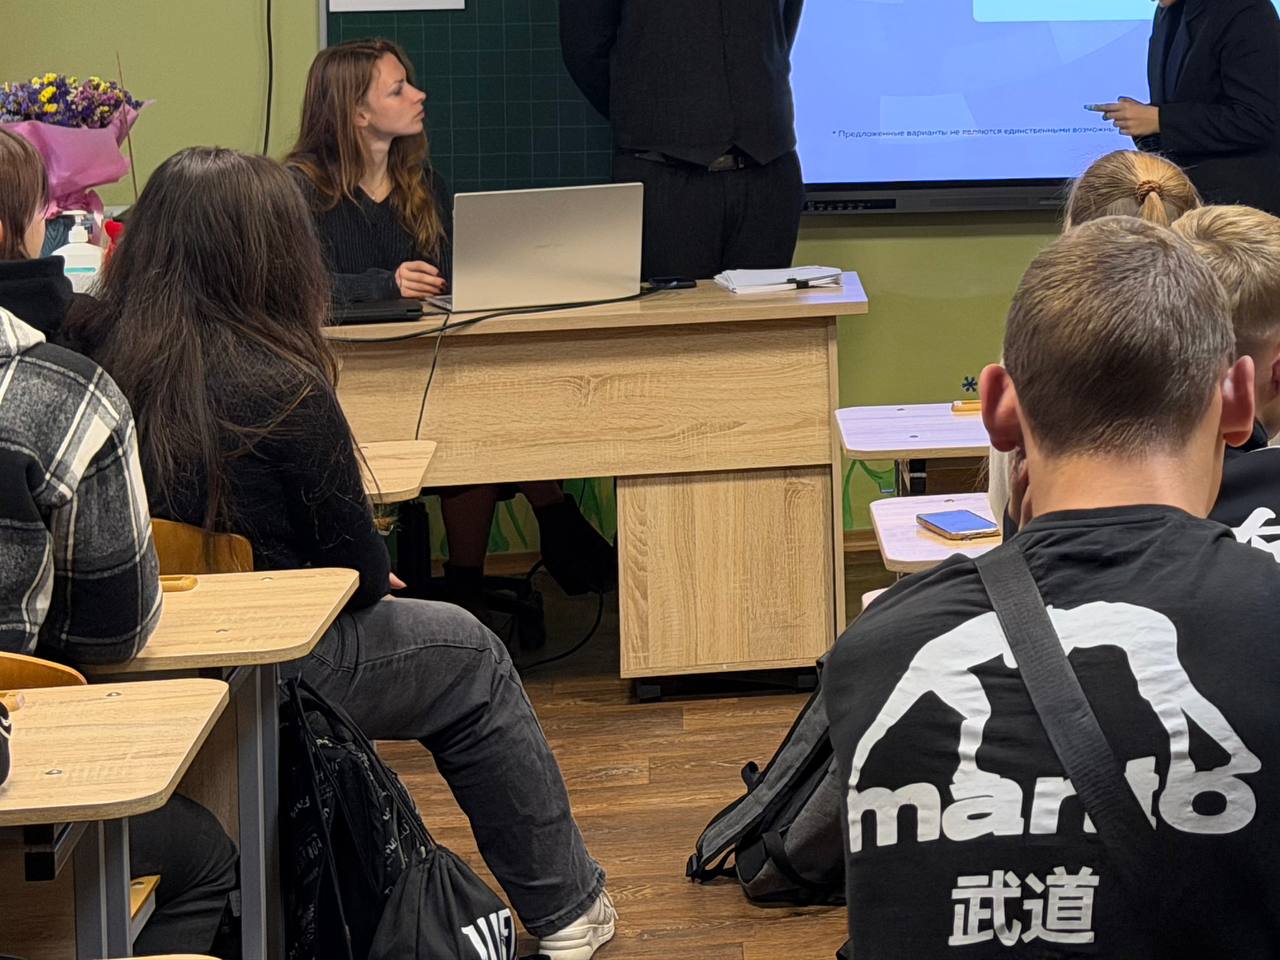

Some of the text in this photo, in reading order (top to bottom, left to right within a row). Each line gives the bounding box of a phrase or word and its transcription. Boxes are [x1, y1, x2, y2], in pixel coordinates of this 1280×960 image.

[838, 129, 905, 139] Предложенные
[906, 129, 948, 138] варианты
[1004, 126, 1071, 136] единственными
[948, 865, 1100, 947] 武道
